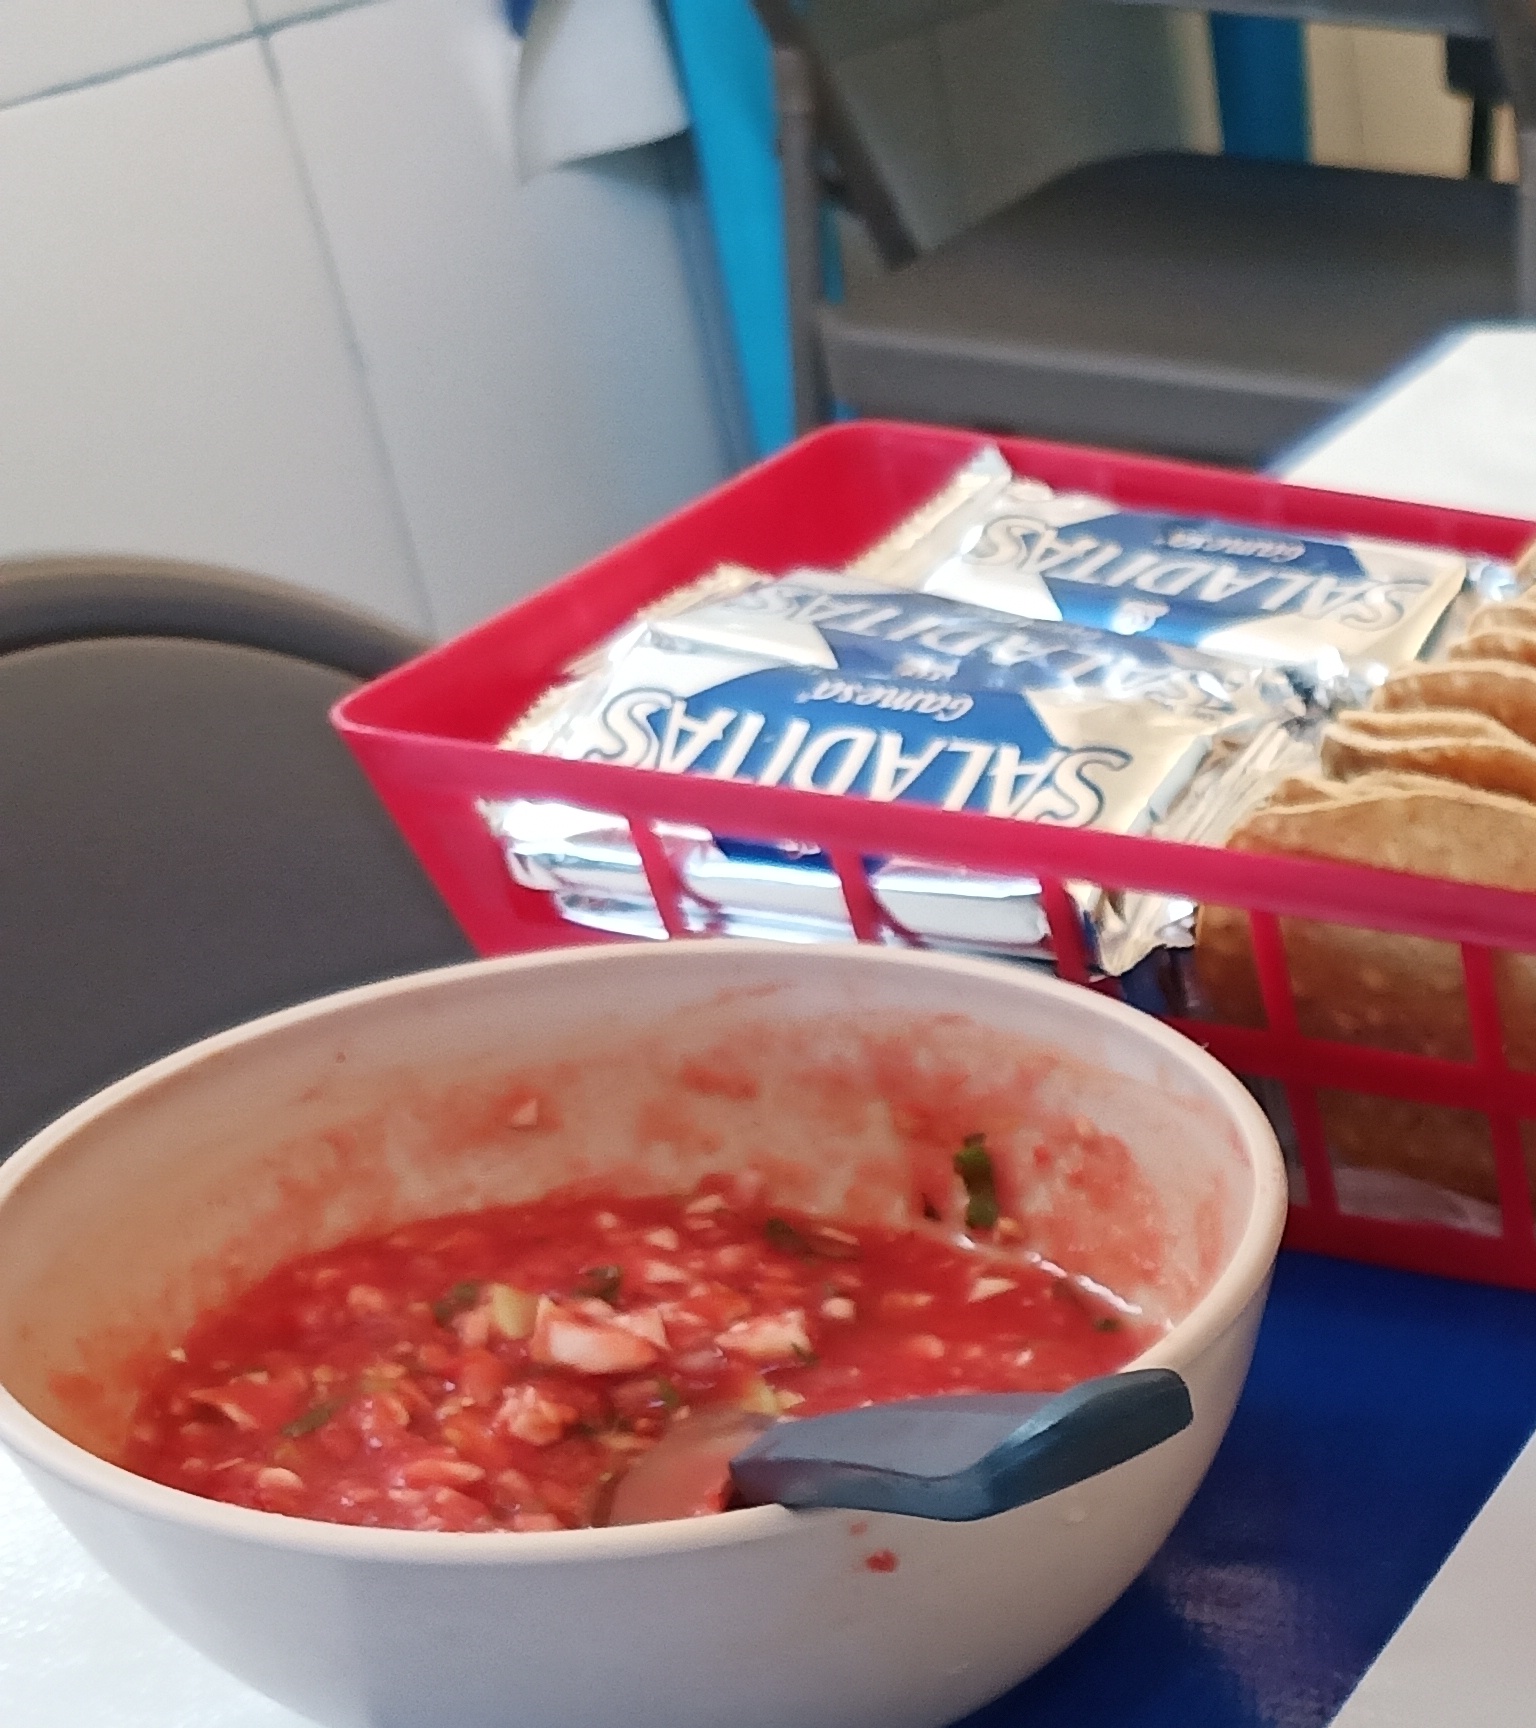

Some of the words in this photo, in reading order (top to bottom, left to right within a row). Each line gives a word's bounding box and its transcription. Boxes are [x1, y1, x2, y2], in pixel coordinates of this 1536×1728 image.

[960, 513, 1430, 633] SALADITAS
[584, 685, 1131, 829] SALADITAS
[811, 678, 975, 722] Gamesa
